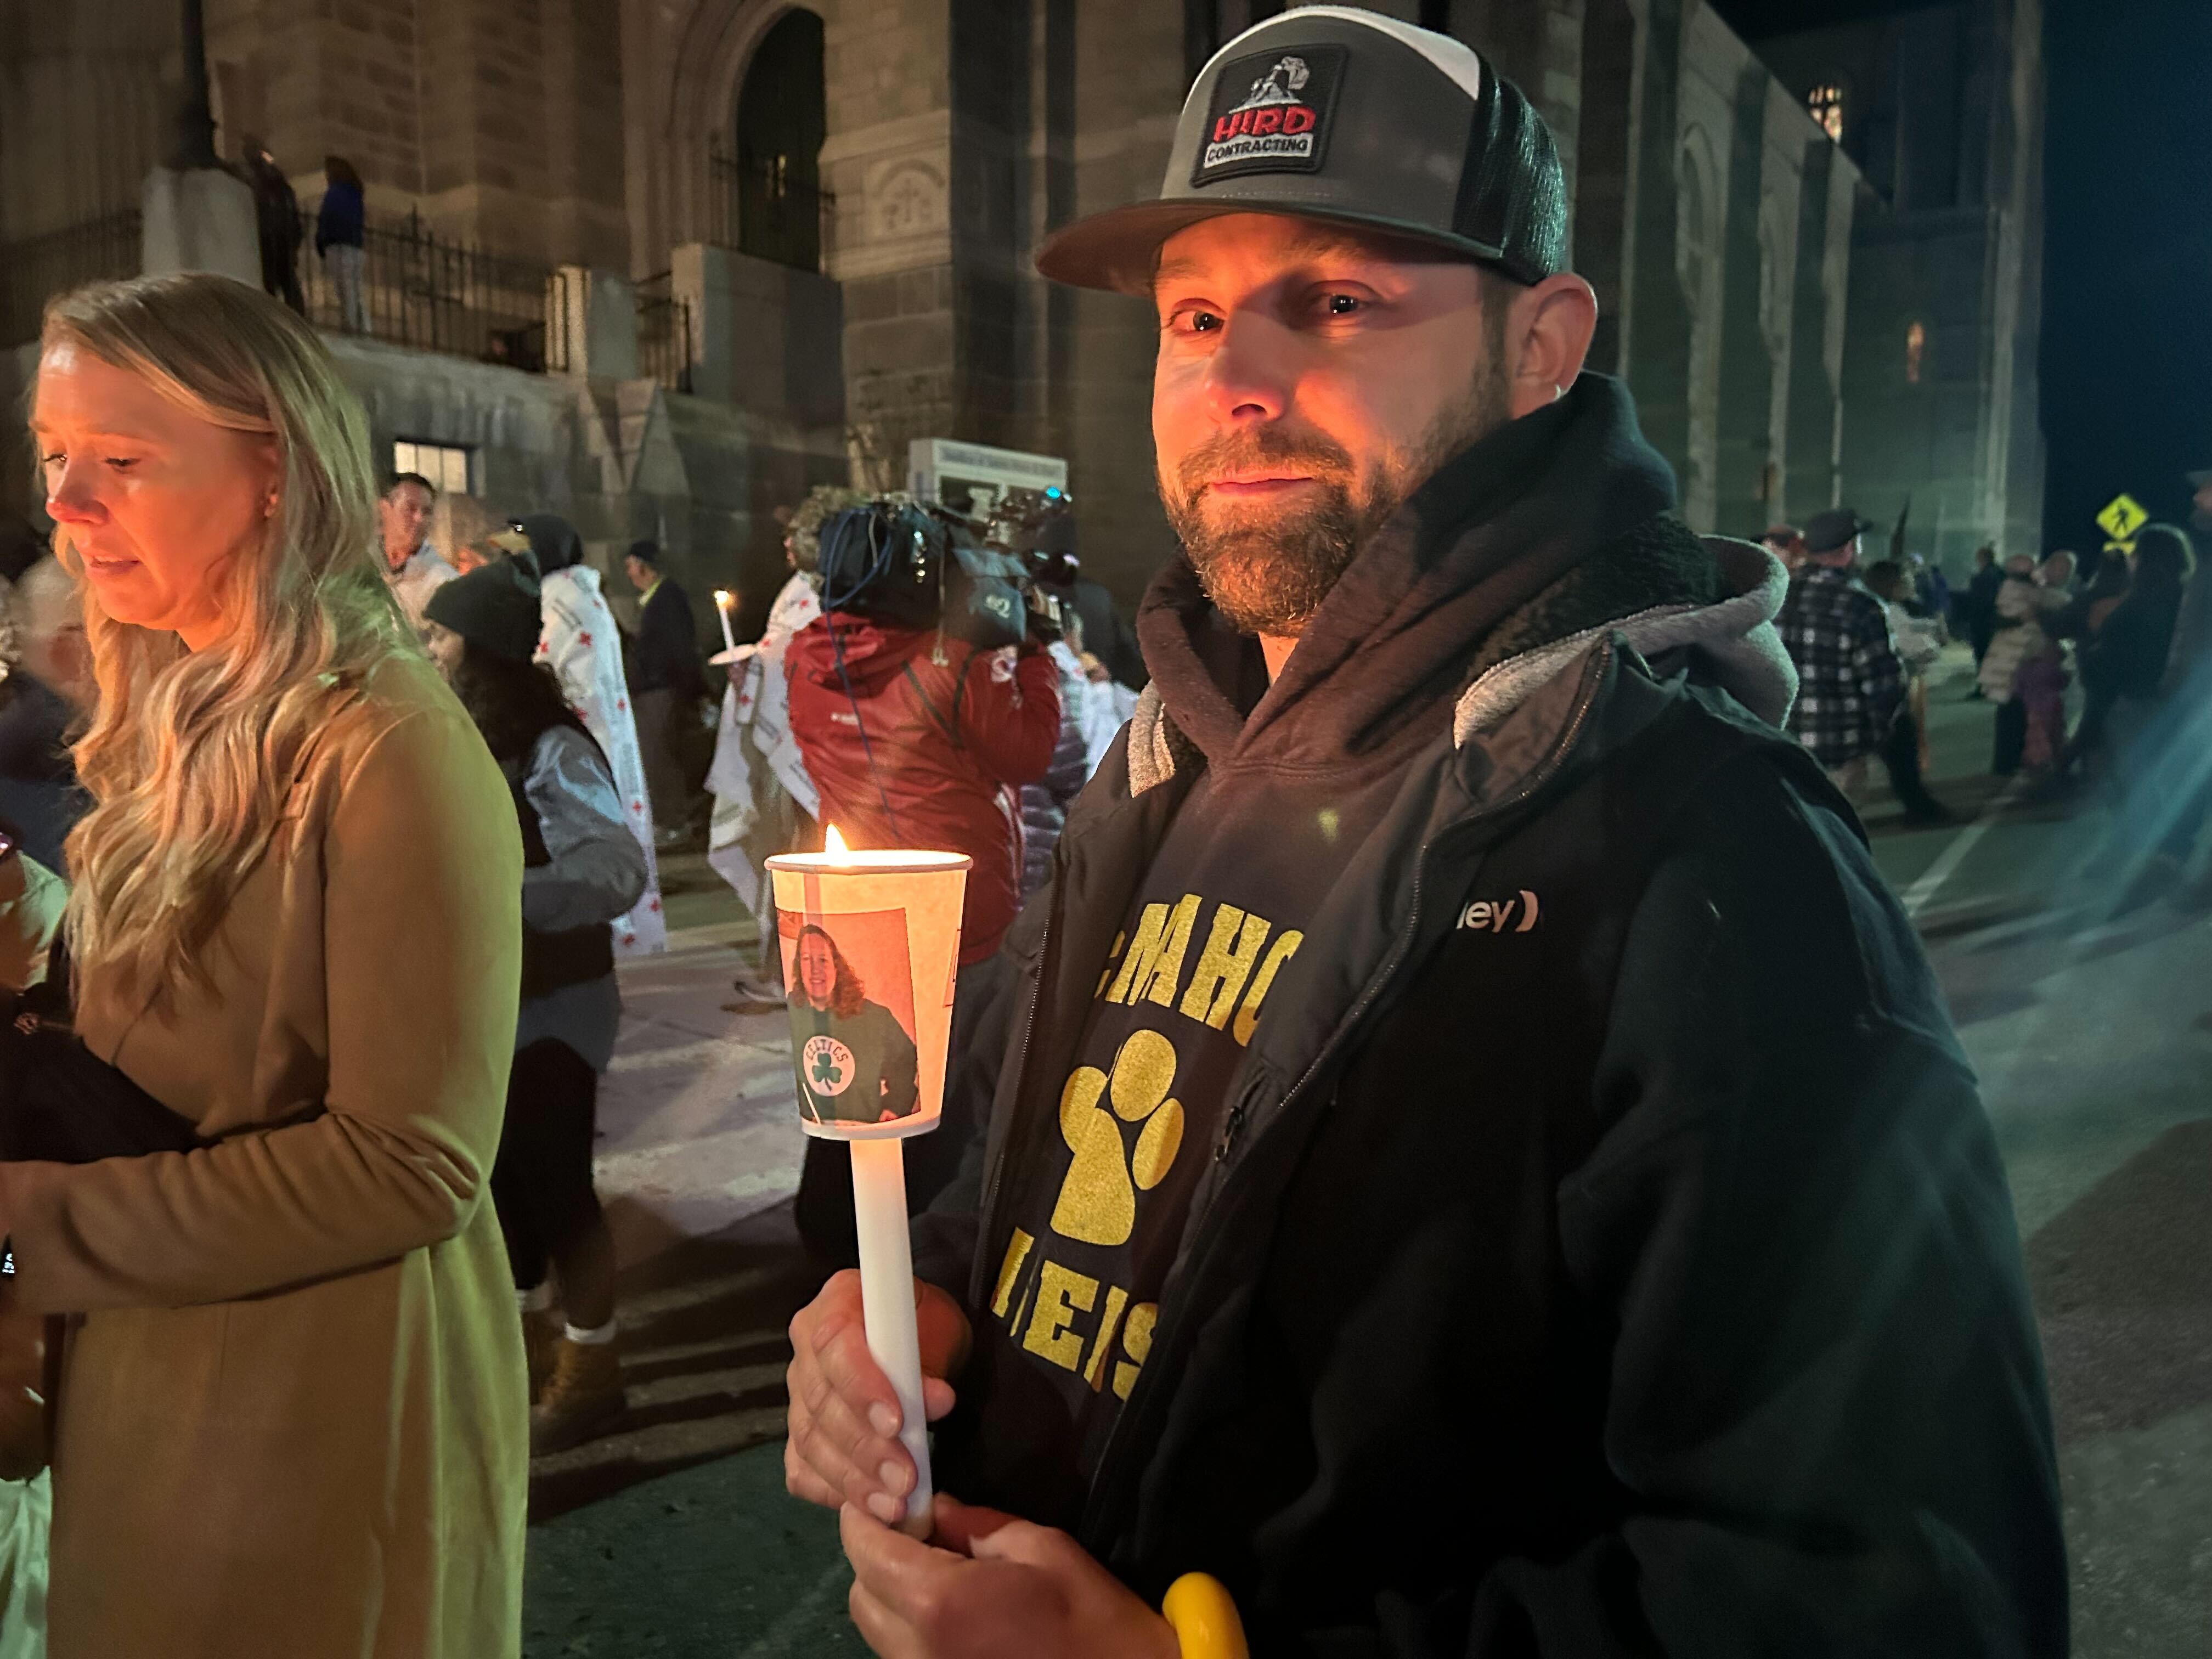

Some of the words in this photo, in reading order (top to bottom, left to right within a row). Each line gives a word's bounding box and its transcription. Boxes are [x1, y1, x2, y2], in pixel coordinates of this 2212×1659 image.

[1213, 106, 1316, 142] HIRD
[1207, 139, 1308, 163] CONTRACTING
[805, 1039, 849, 1062] CELTICS
